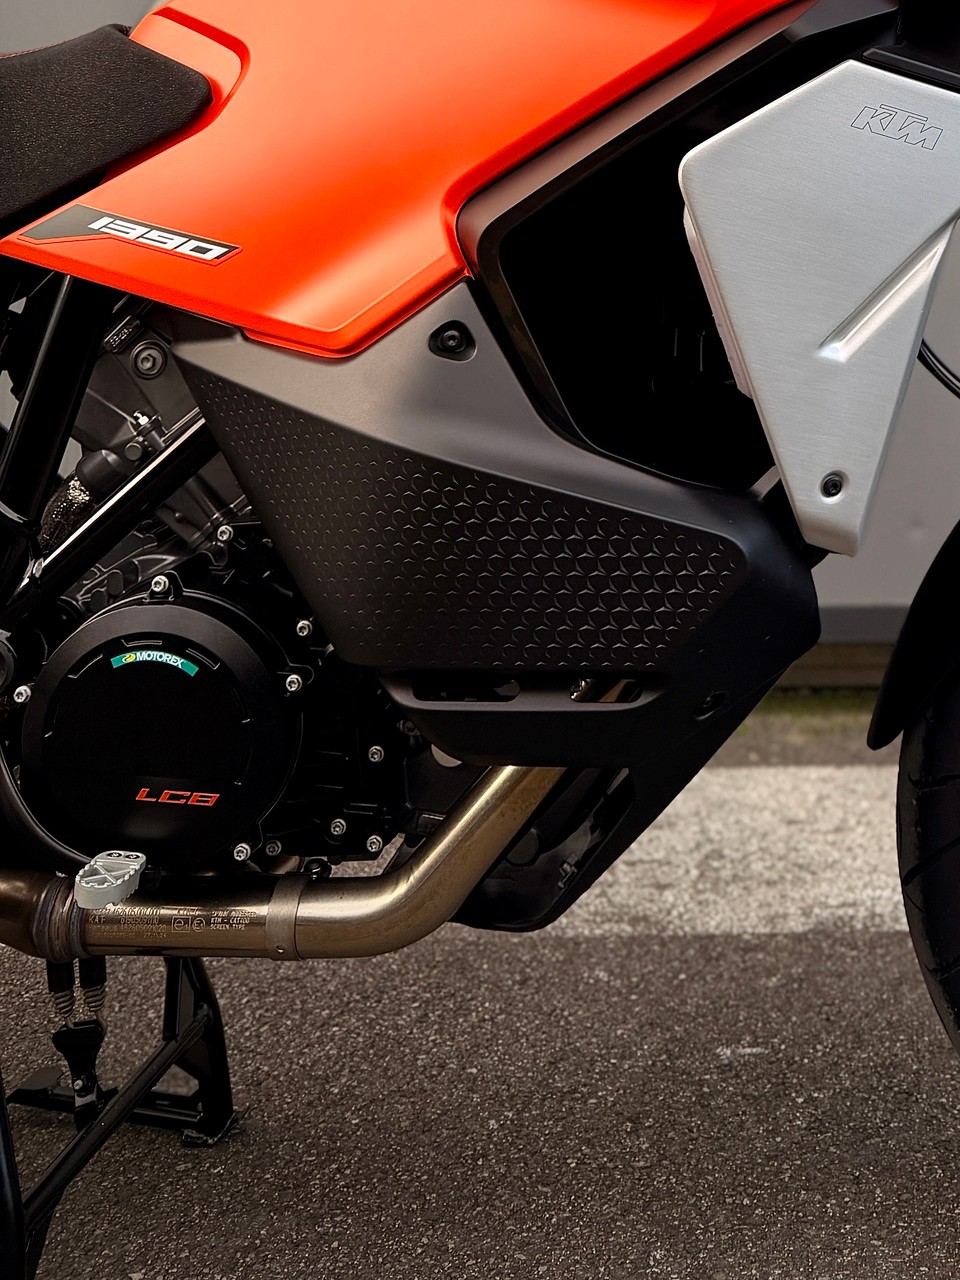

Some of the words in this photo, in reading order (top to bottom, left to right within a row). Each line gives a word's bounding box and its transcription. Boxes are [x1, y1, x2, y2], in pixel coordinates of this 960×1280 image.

[850, 103, 944, 151] KTM
[87, 216, 230, 261] 1390
[136, 650, 185, 669] MOTOREX
[135, 787, 220, 807] LC8
